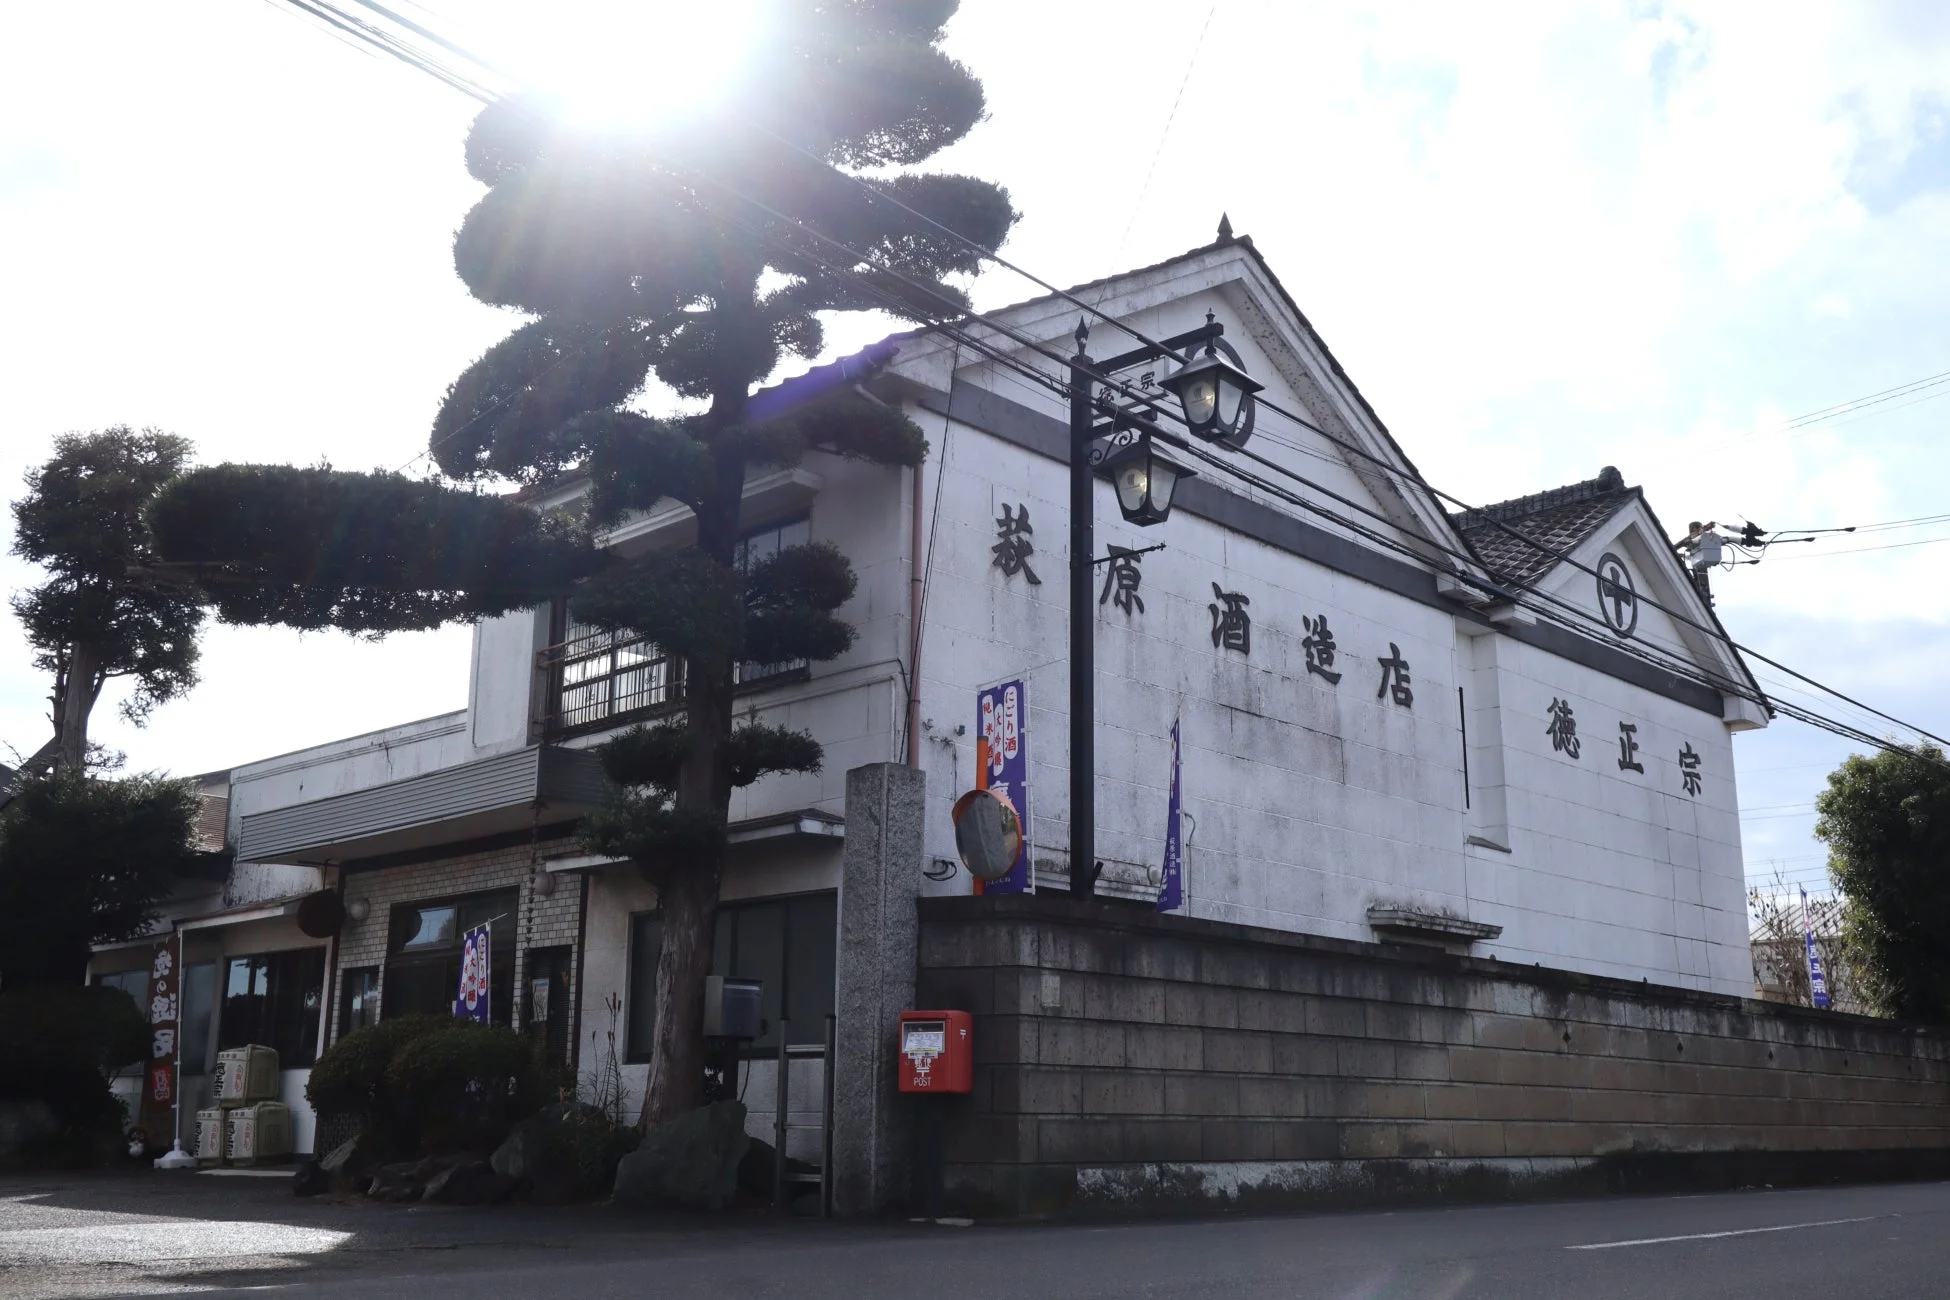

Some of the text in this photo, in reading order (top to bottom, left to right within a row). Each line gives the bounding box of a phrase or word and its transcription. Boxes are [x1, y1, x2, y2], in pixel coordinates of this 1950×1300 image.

[1004, 691, 1017, 752] にごり酒
[1546, 697, 1702, 800] 徳正宗
[478, 938, 486, 990] にごり酒
[913, 1077, 931, 1087] POST
